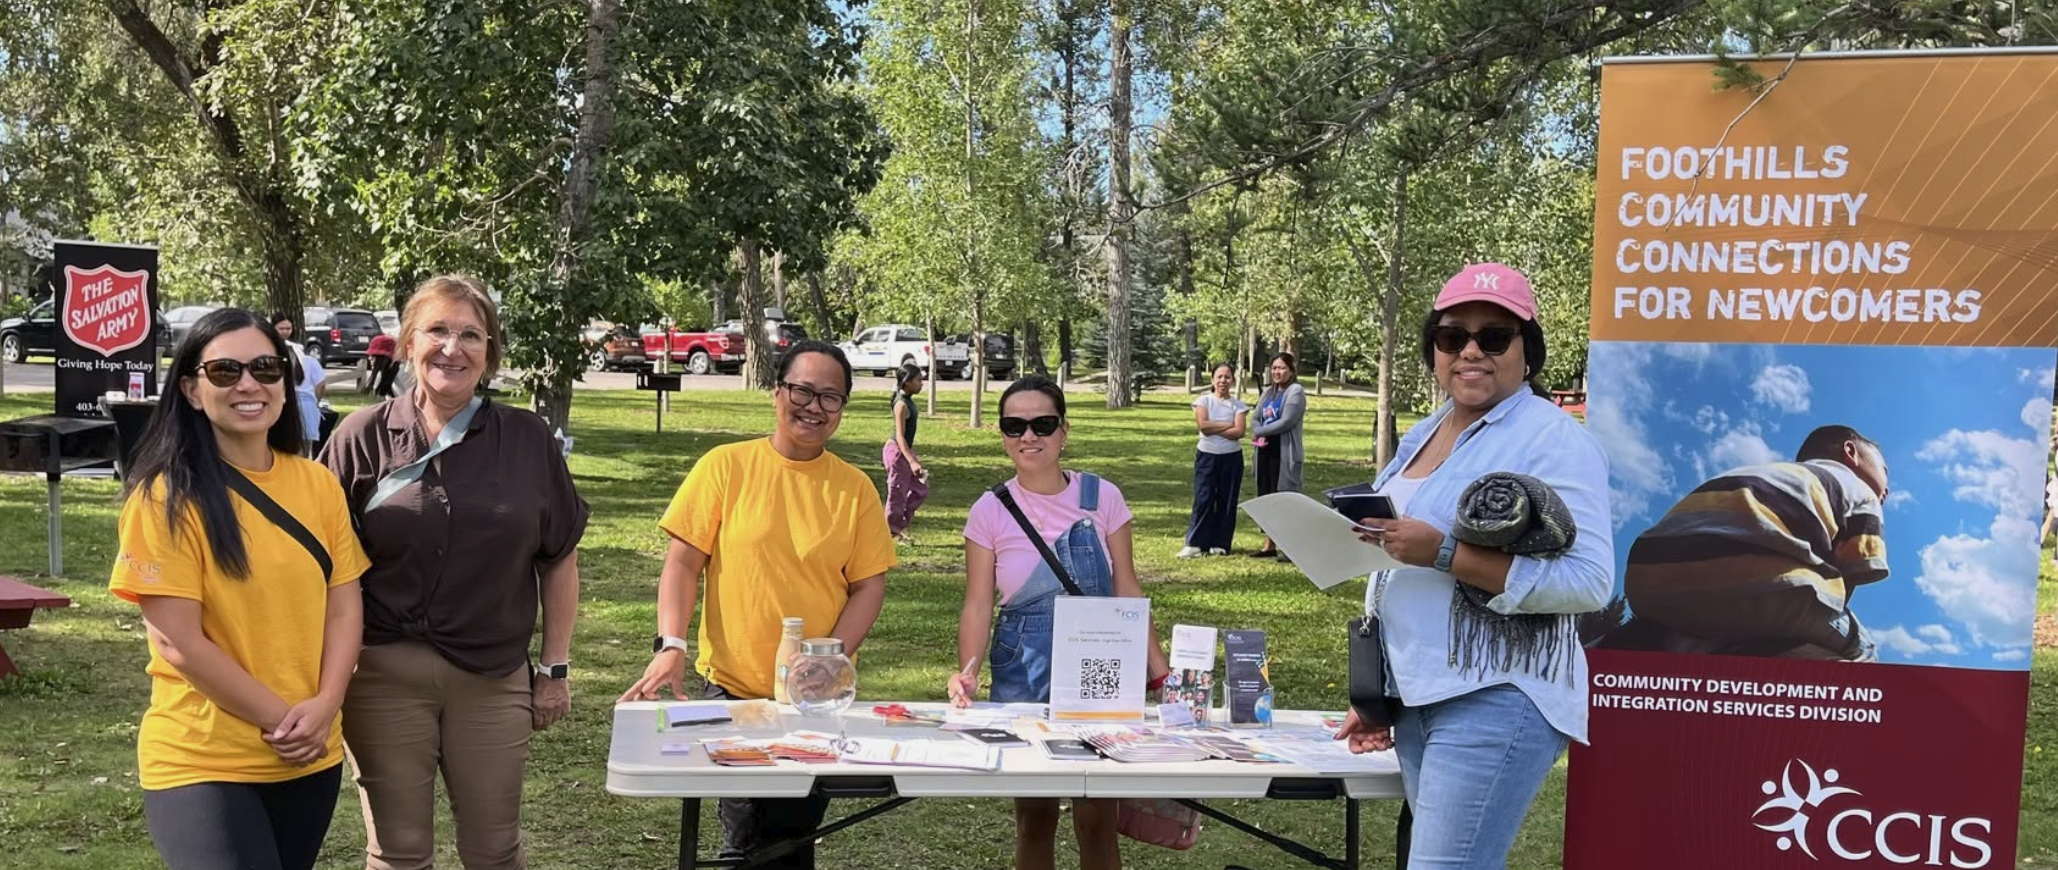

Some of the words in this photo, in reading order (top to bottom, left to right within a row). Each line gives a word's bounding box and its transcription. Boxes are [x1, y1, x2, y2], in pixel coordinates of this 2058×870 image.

[1621, 145, 1849, 180] FOOTHILLS
[1618, 192, 1868, 227] COMMUNITY
[1616, 238, 1911, 275] CONNECTIONS
[81, 277, 114, 302] THE
[1474, 271, 1499, 290] NY
[71, 284, 138, 329] SALVATION
[1614, 286, 1692, 319] FOR
[1707, 287, 1982, 323] NEWCOMERS
[97, 307, 138, 342] ARMY
[57, 358, 93, 371] Giving
[95, 360, 122, 372] Hope
[124, 361, 154, 373] Today
[1593, 673, 1702, 692] COMMUNITY
[1706, 679, 1839, 700] DEVELOPMENT
[1842, 687, 1883, 703] AND
[1592, 693, 1708, 713] INTEGRATION
[1712, 700, 1795, 718] SERVICES
[1799, 705, 1882, 723] DIVISION
[1826, 808, 1993, 869] CCIS
